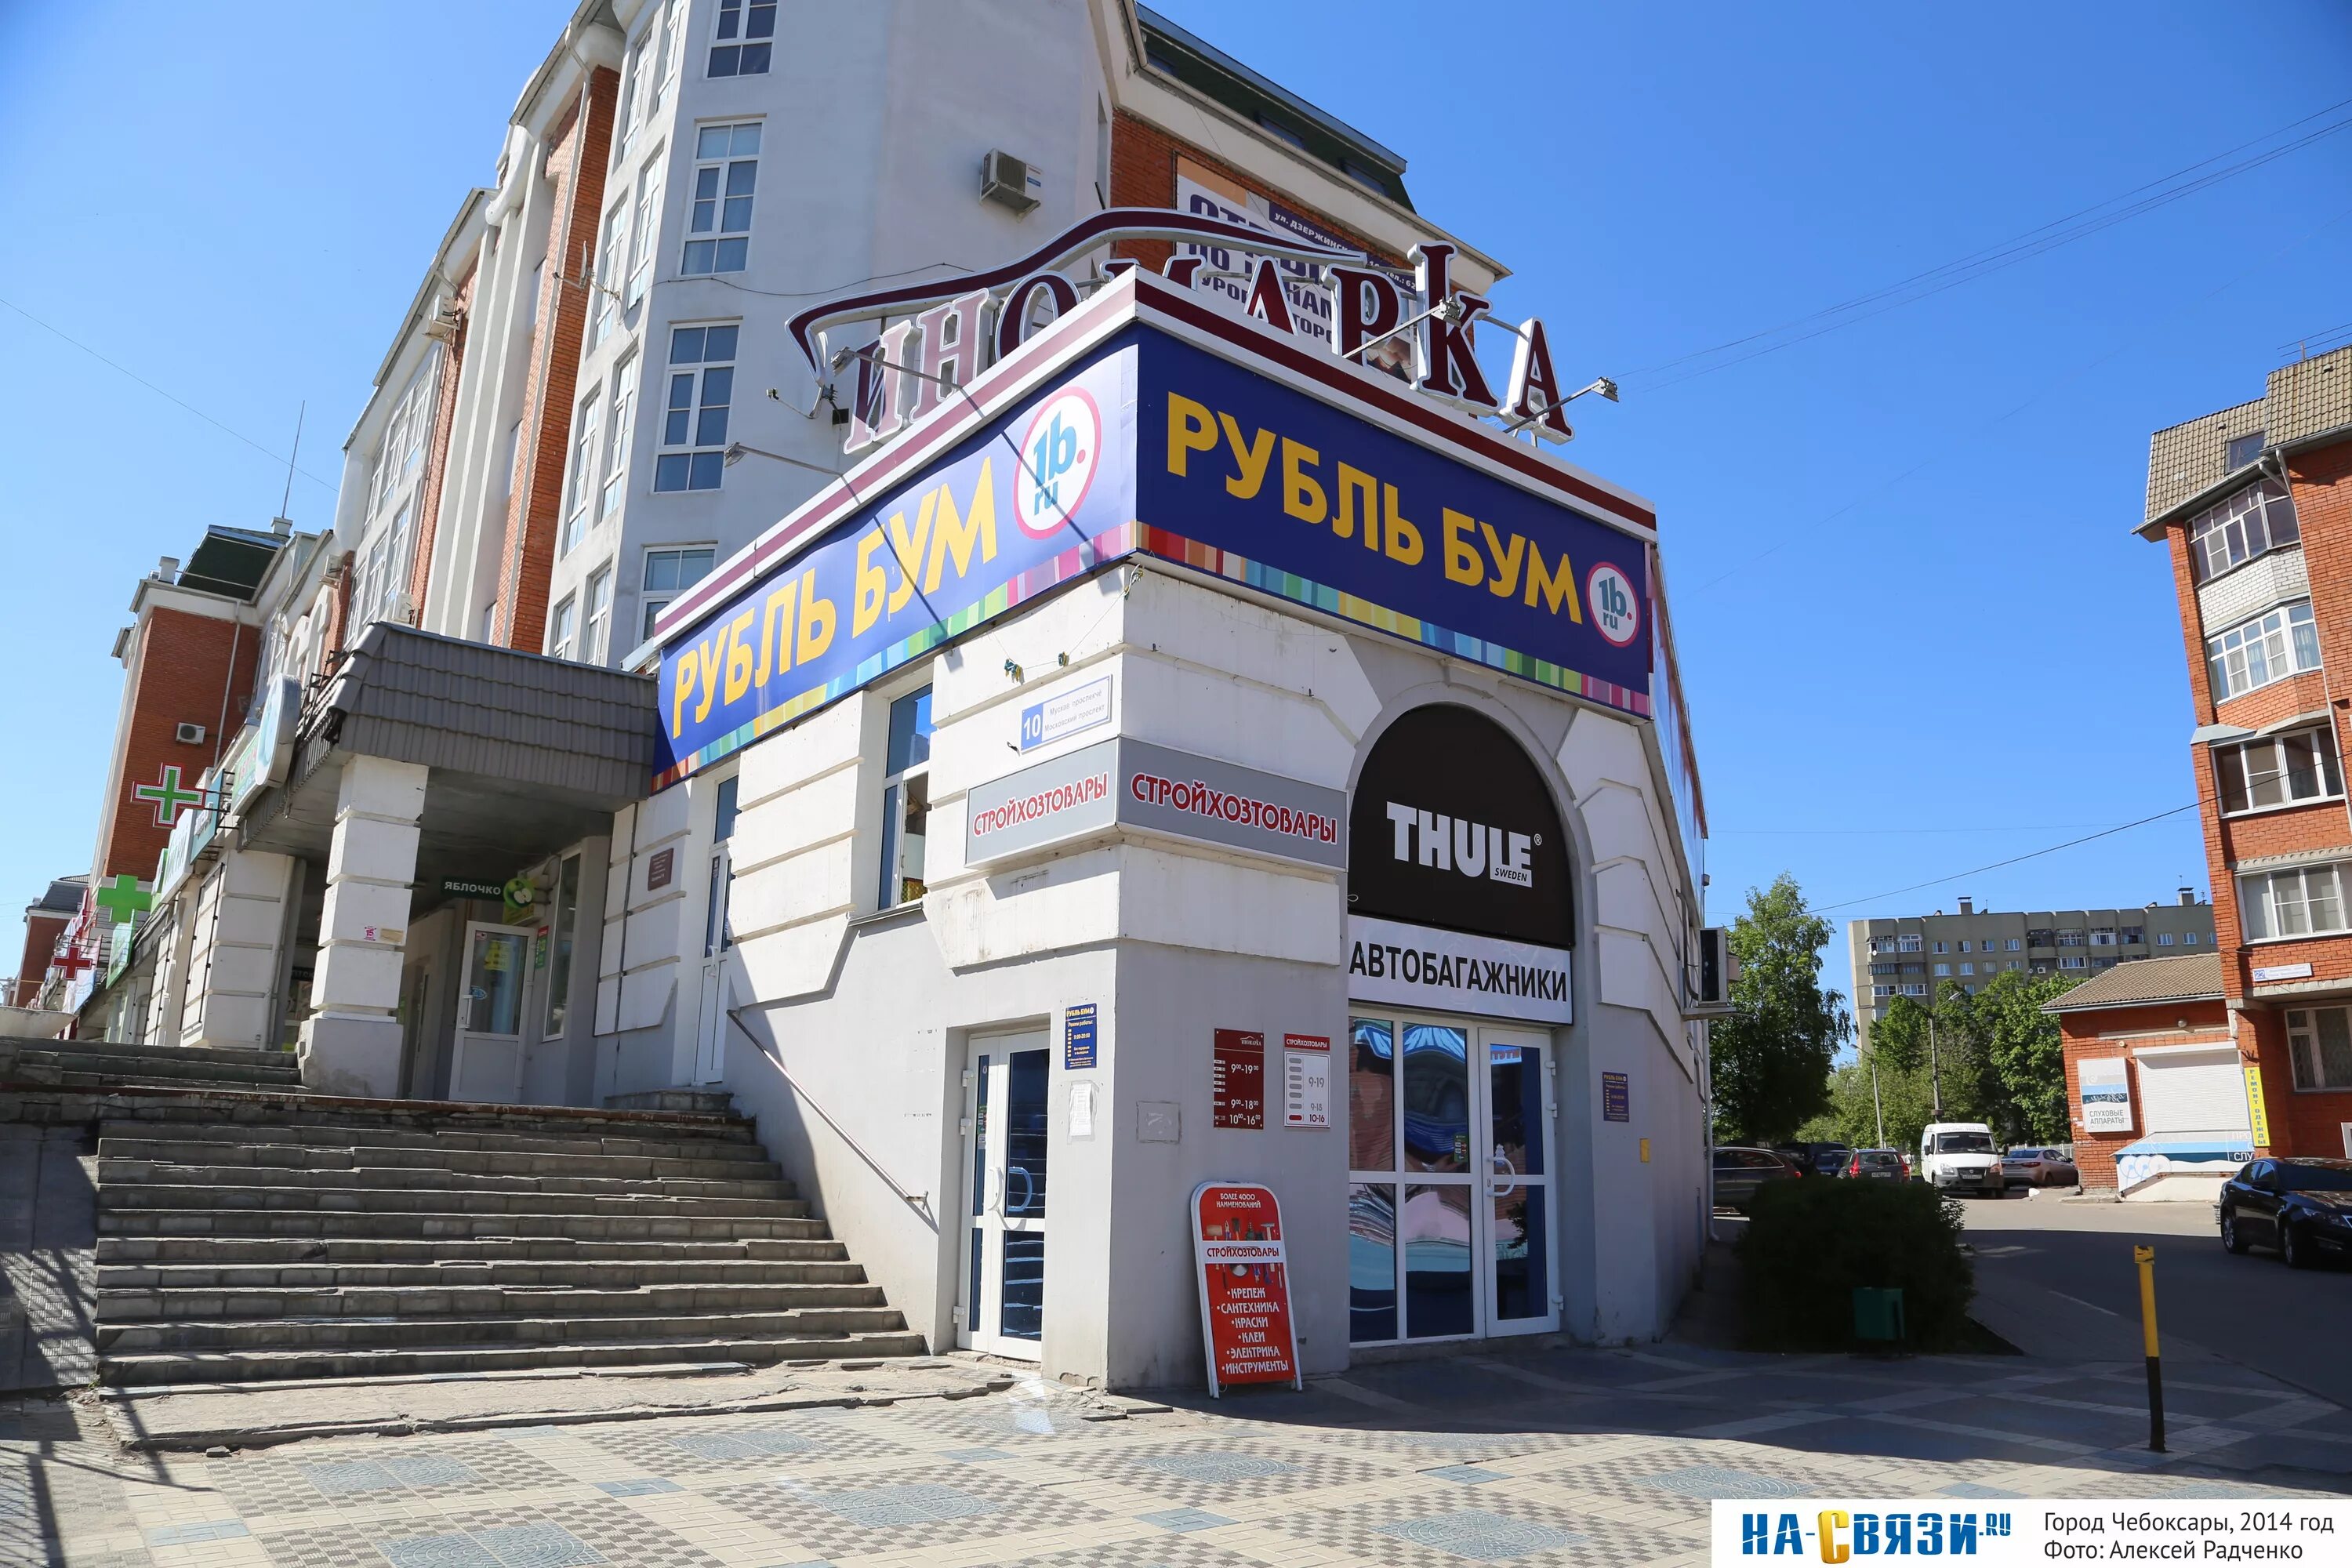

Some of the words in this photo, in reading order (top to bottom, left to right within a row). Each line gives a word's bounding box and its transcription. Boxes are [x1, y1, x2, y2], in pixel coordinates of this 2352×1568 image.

[1167, 390, 1424, 566] РУБЛЬ
[1443, 506, 1583, 625] БУМ
[673, 568, 837, 739] РУБЛЬ
[852, 456, 997, 639] БУМ
[1602, 612, 1618, 630] ru
[1050, 702, 1070, 716] Мускав
[1044, 714, 1077, 731] Московский
[1078, 704, 1105, 720] проспект
[1023, 713, 1041, 741] 10
[973, 771, 1108, 837] СТРОЙХОЗТОВАРЫ
[1131, 771, 1338, 845] СТРОЙХОЗТОВАРЫ
[1494, 867, 1527, 882] SWEDEN
[445, 881, 501, 895] ЯБЛОЧКО
[1348, 941, 1567, 1002] АВТОБАГАЖНИКИ
[1286, 1039, 1327, 1048] СТРОЙХОЗТОВАРЫ
[1308, 1076, 1325, 1088] 9-19
[2249, 1069, 2259, 1105] РЕМОНТ
[1310, 1103, 1323, 1112] 9-18
[1308, 1114, 1325, 1123] 10-16
[1207, 1247, 1279, 1258] СТРОЙХОЗТОВАРЫ
[1231, 1287, 1265, 1299] КРЕПЕЖ
[1221, 1301, 1279, 1314] САНТЕХНИКА
[1235, 1317, 1269, 1329] КРАСКИ
[1230, 1345, 1280, 1359] ЭЛЕКТРИКА
[1225, 1360, 1289, 1374] ИНСТРУМЕНТЫ
